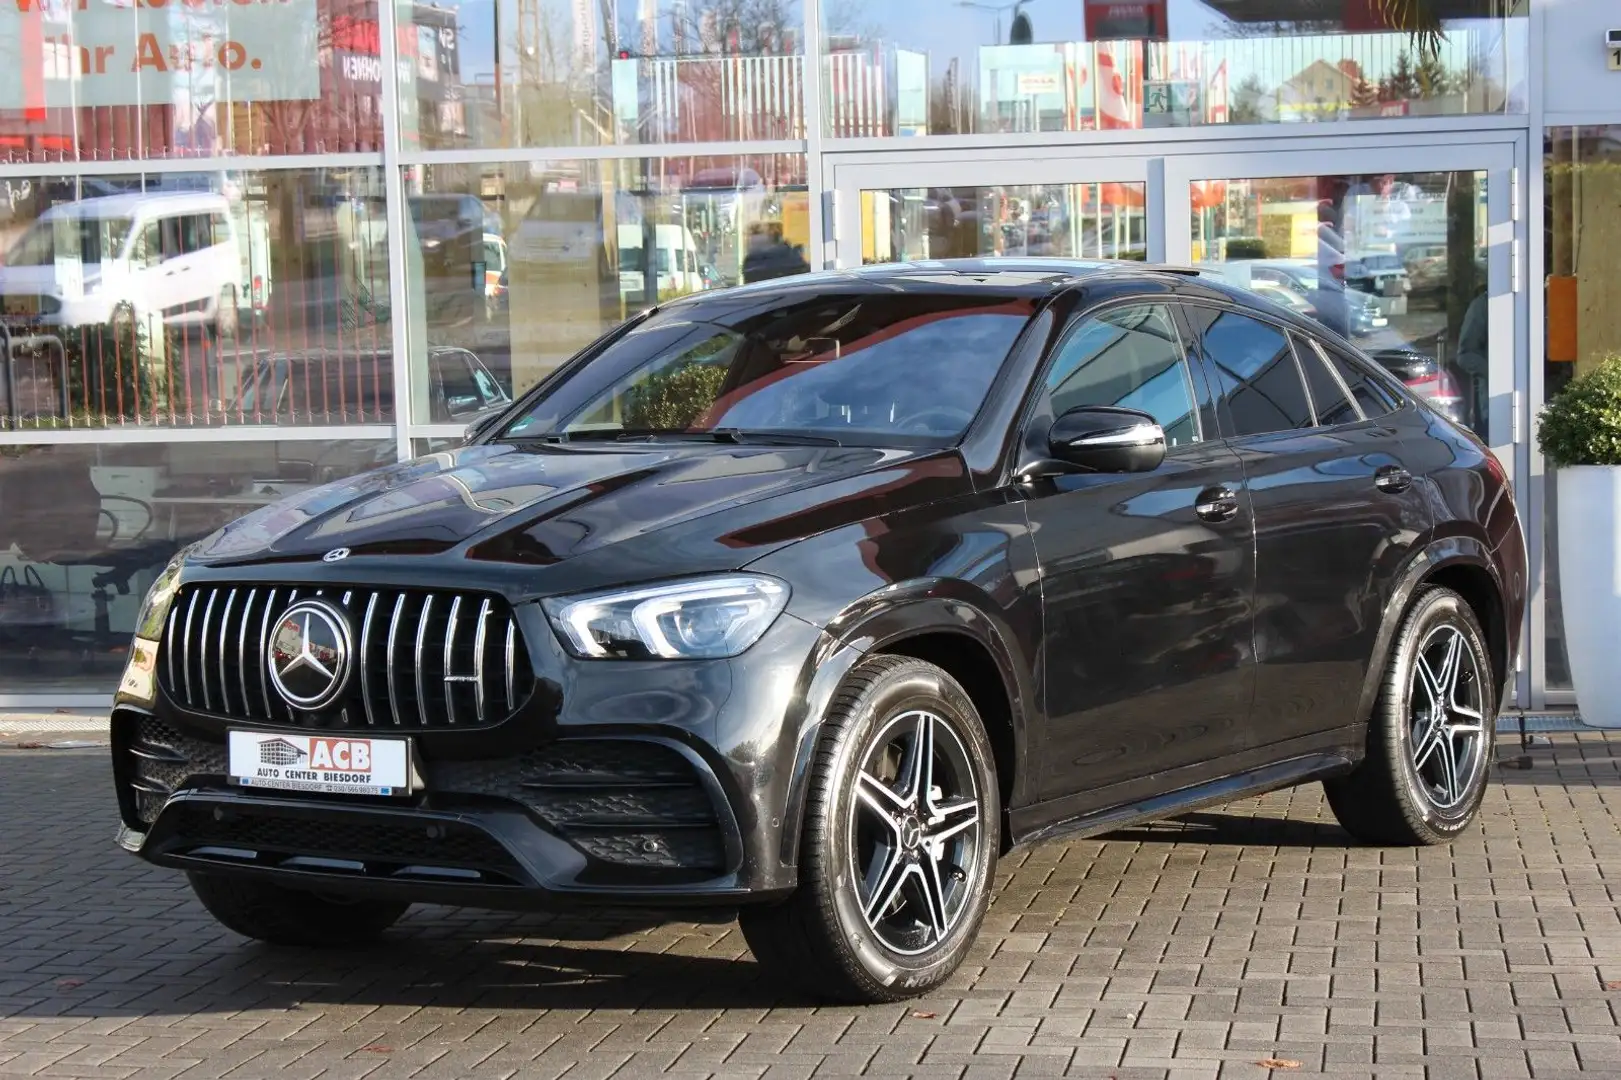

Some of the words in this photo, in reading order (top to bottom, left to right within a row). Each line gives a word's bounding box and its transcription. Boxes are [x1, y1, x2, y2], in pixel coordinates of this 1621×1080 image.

[311, 740, 370, 770] ACB
[257, 768, 280, 778] AUTO
[285, 770, 318, 781] CENTER
[324, 772, 371, 783] BIESDORF
